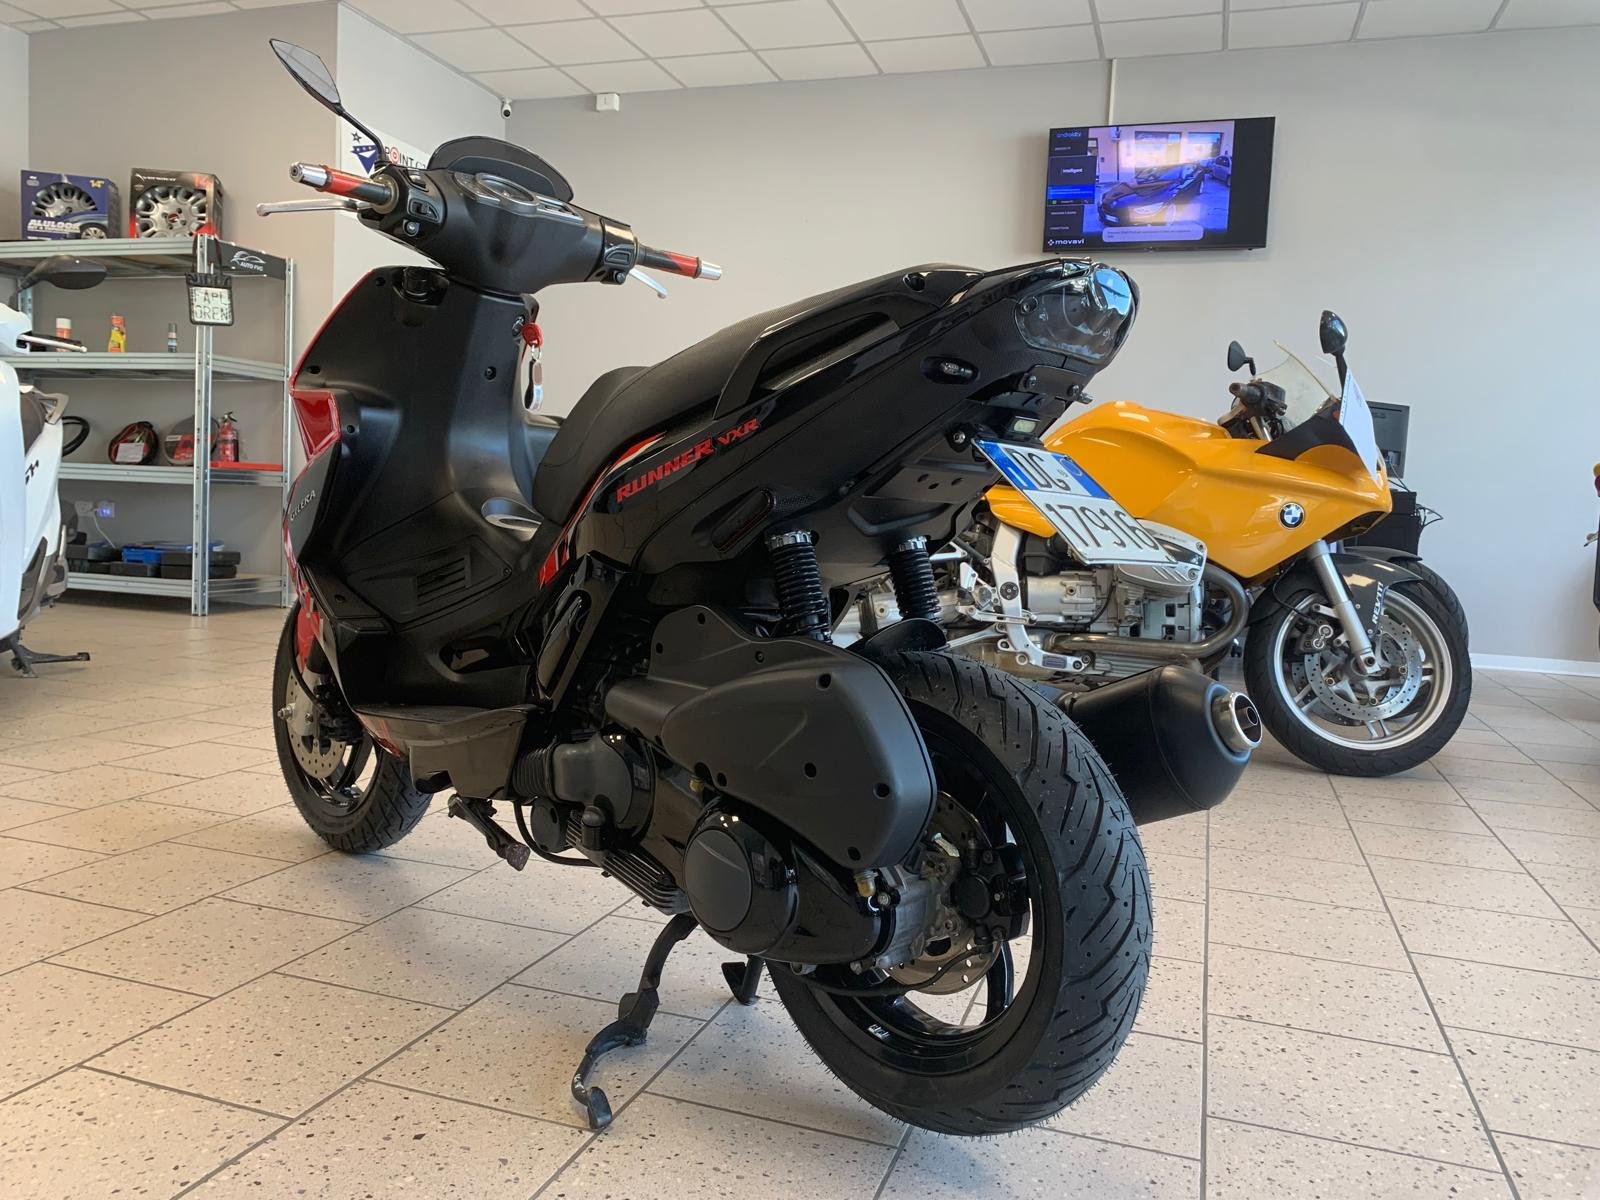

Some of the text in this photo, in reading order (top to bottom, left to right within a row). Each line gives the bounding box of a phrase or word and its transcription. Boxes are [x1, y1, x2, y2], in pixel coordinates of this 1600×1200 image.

[616, 417, 760, 503] RUNNER VXR
[1004, 447, 1071, 492] DG
[1045, 503, 1160, 550] 17916
